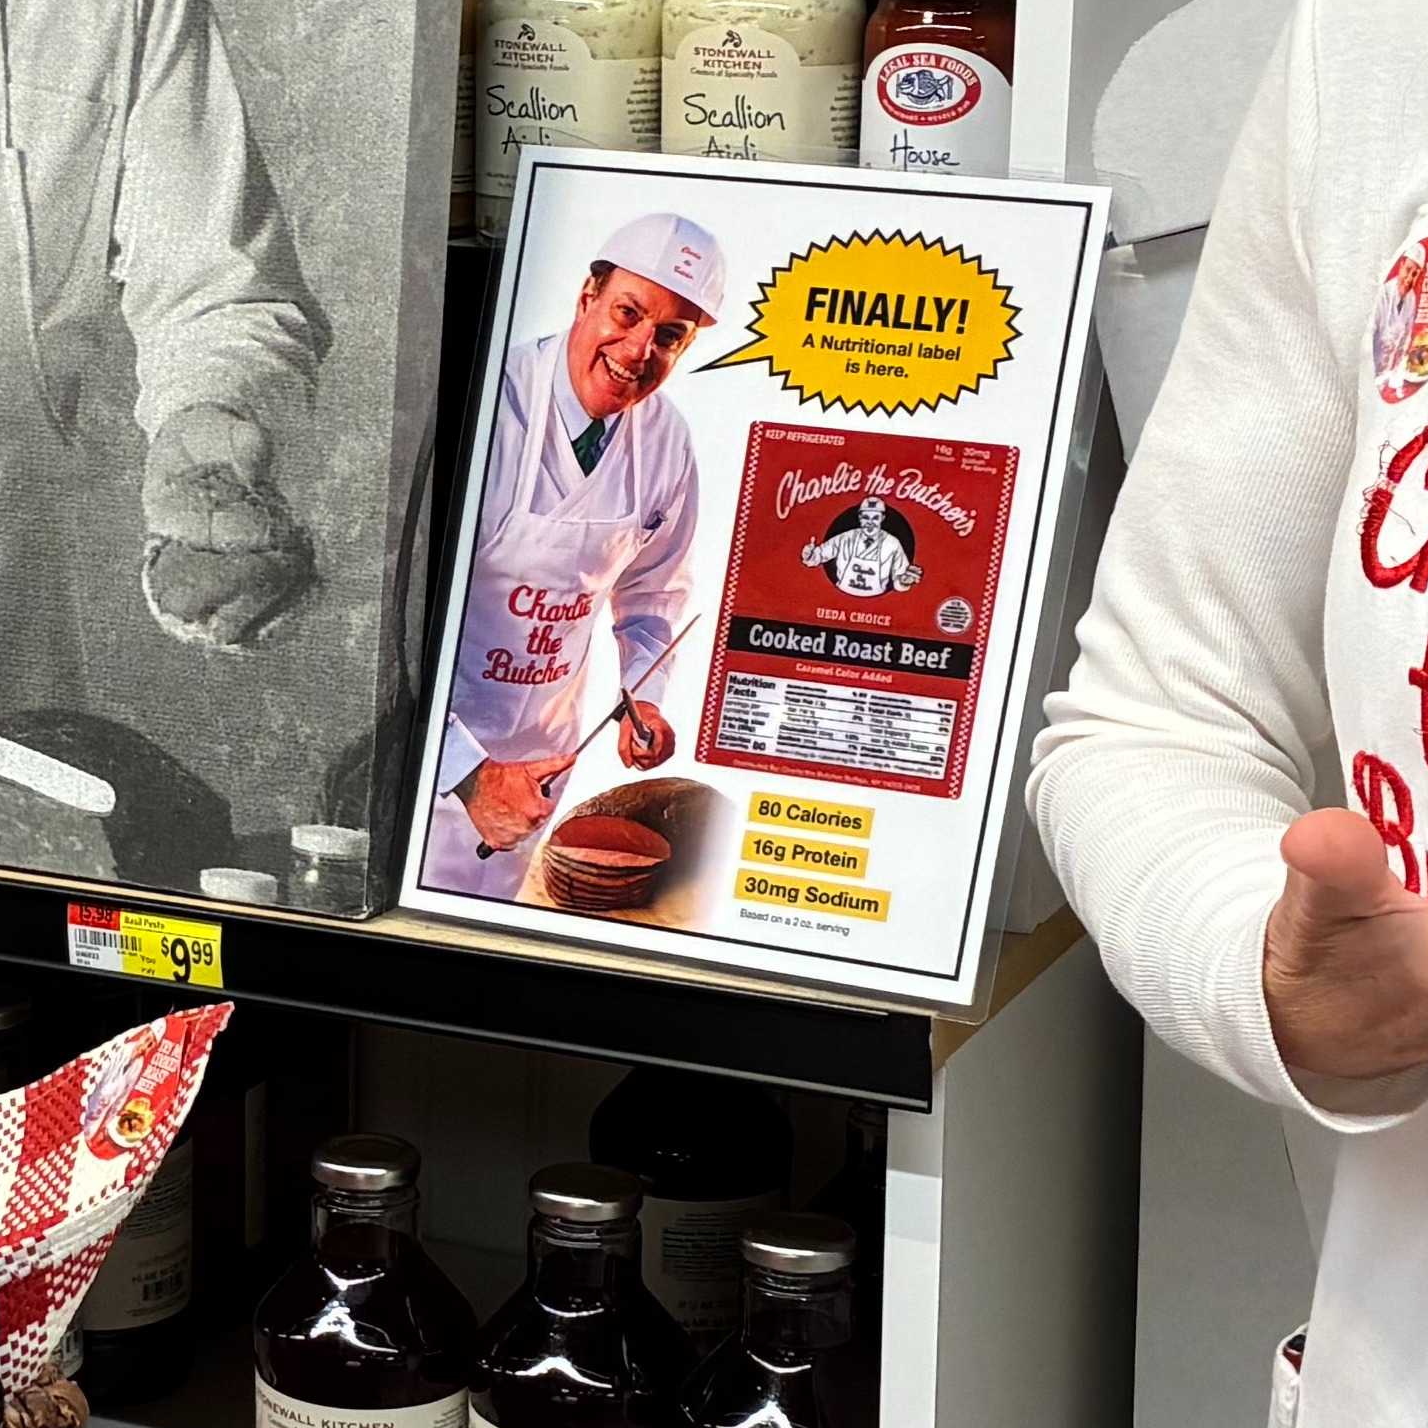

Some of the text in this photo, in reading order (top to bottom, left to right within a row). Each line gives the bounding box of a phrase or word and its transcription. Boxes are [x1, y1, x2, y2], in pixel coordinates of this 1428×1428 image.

[494, 39, 566, 53] STONEWALL
[502, 51, 555, 63] KITCHEN
[693, 47, 775, 60] STONEWALL
[702, 59, 763, 70] KITCHEN
[879, 53, 977, 87] LEGAL SEA FOODS
[486, 84, 579, 123] Scallion
[684, 94, 786, 131] Scallion
[889, 128, 961, 167] House
[804, 287, 970, 335] FINALLY!
[802, 333, 961, 361] A Nutritional label
[845, 359, 909, 379] is here.
[764, 429, 845, 446] KEEP REFRIGERATED
[776, 462, 977, 538] Charlie the Butcher's
[508, 584, 594, 623] Charlie
[816, 607, 891, 626] USDA CHOICE
[526, 624, 562, 655] the
[749, 624, 952, 670] Cooked Roast Beef
[482, 648, 572, 687] Butcher
[758, 800, 862, 830] 80 Calories
[753, 839, 858, 869] 16g Protein
[744, 877, 879, 913] 30mg Sodium
